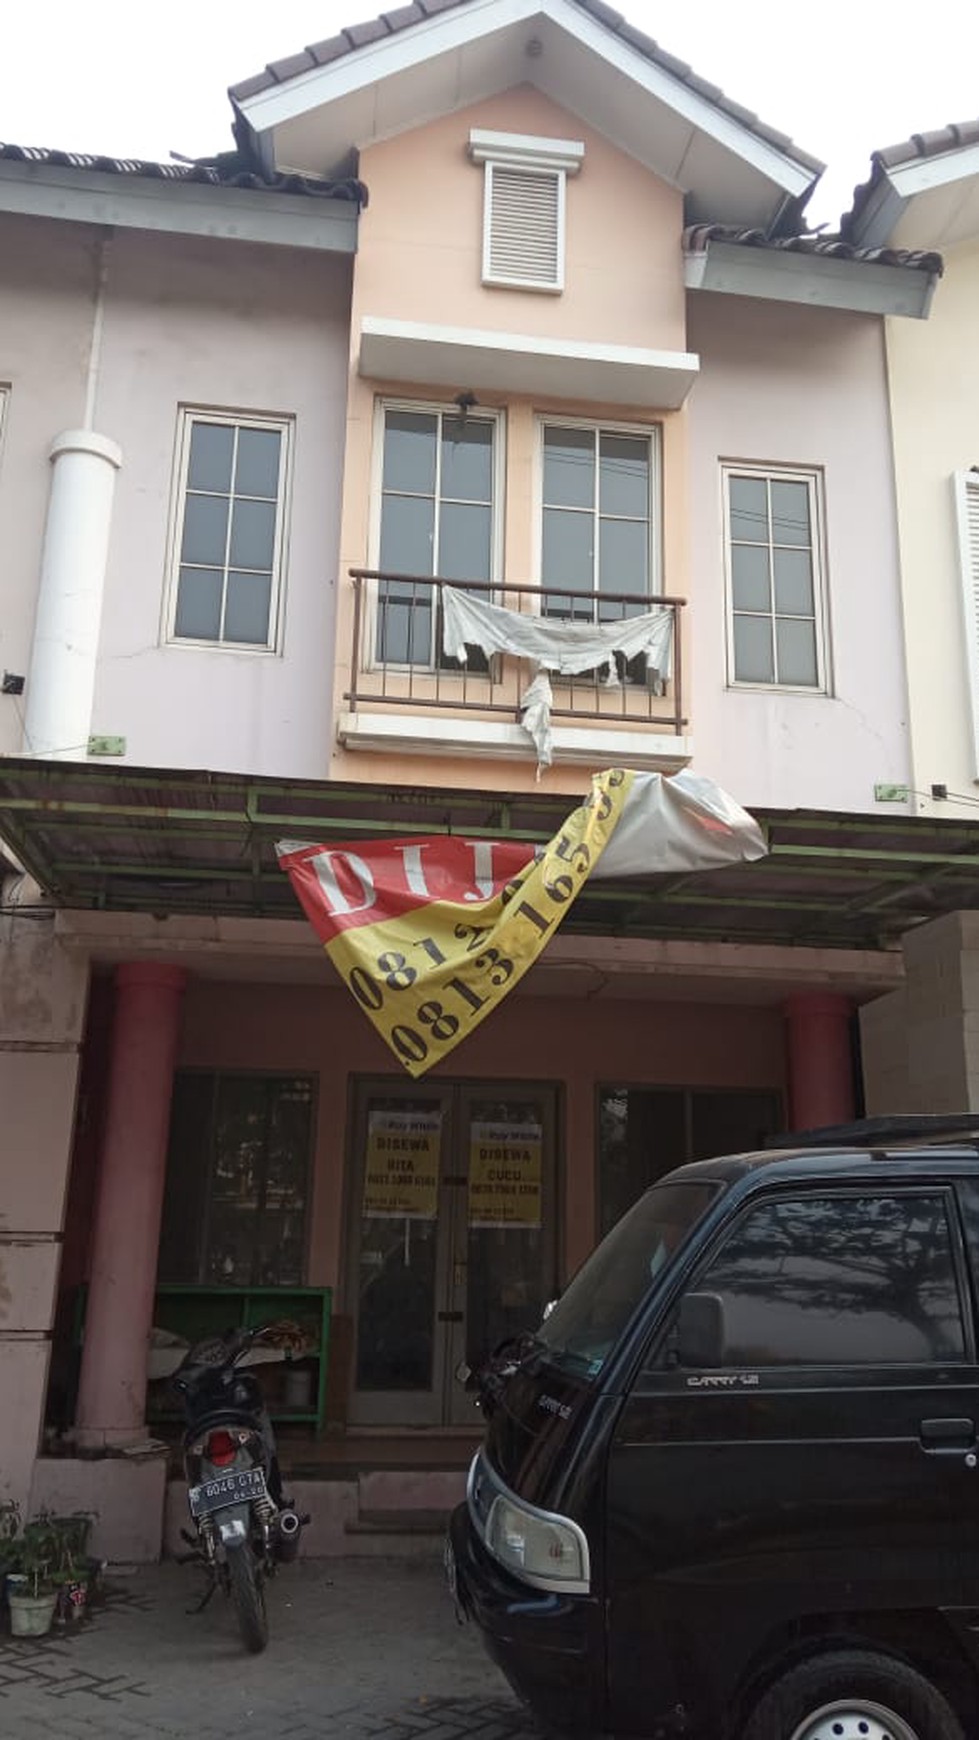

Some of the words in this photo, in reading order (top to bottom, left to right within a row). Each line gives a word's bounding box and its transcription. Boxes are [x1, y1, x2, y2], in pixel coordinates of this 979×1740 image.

[304, 842, 545, 917] DIJ
[349, 921, 496, 1011] 0812
[391, 947, 515, 1064] 0813
